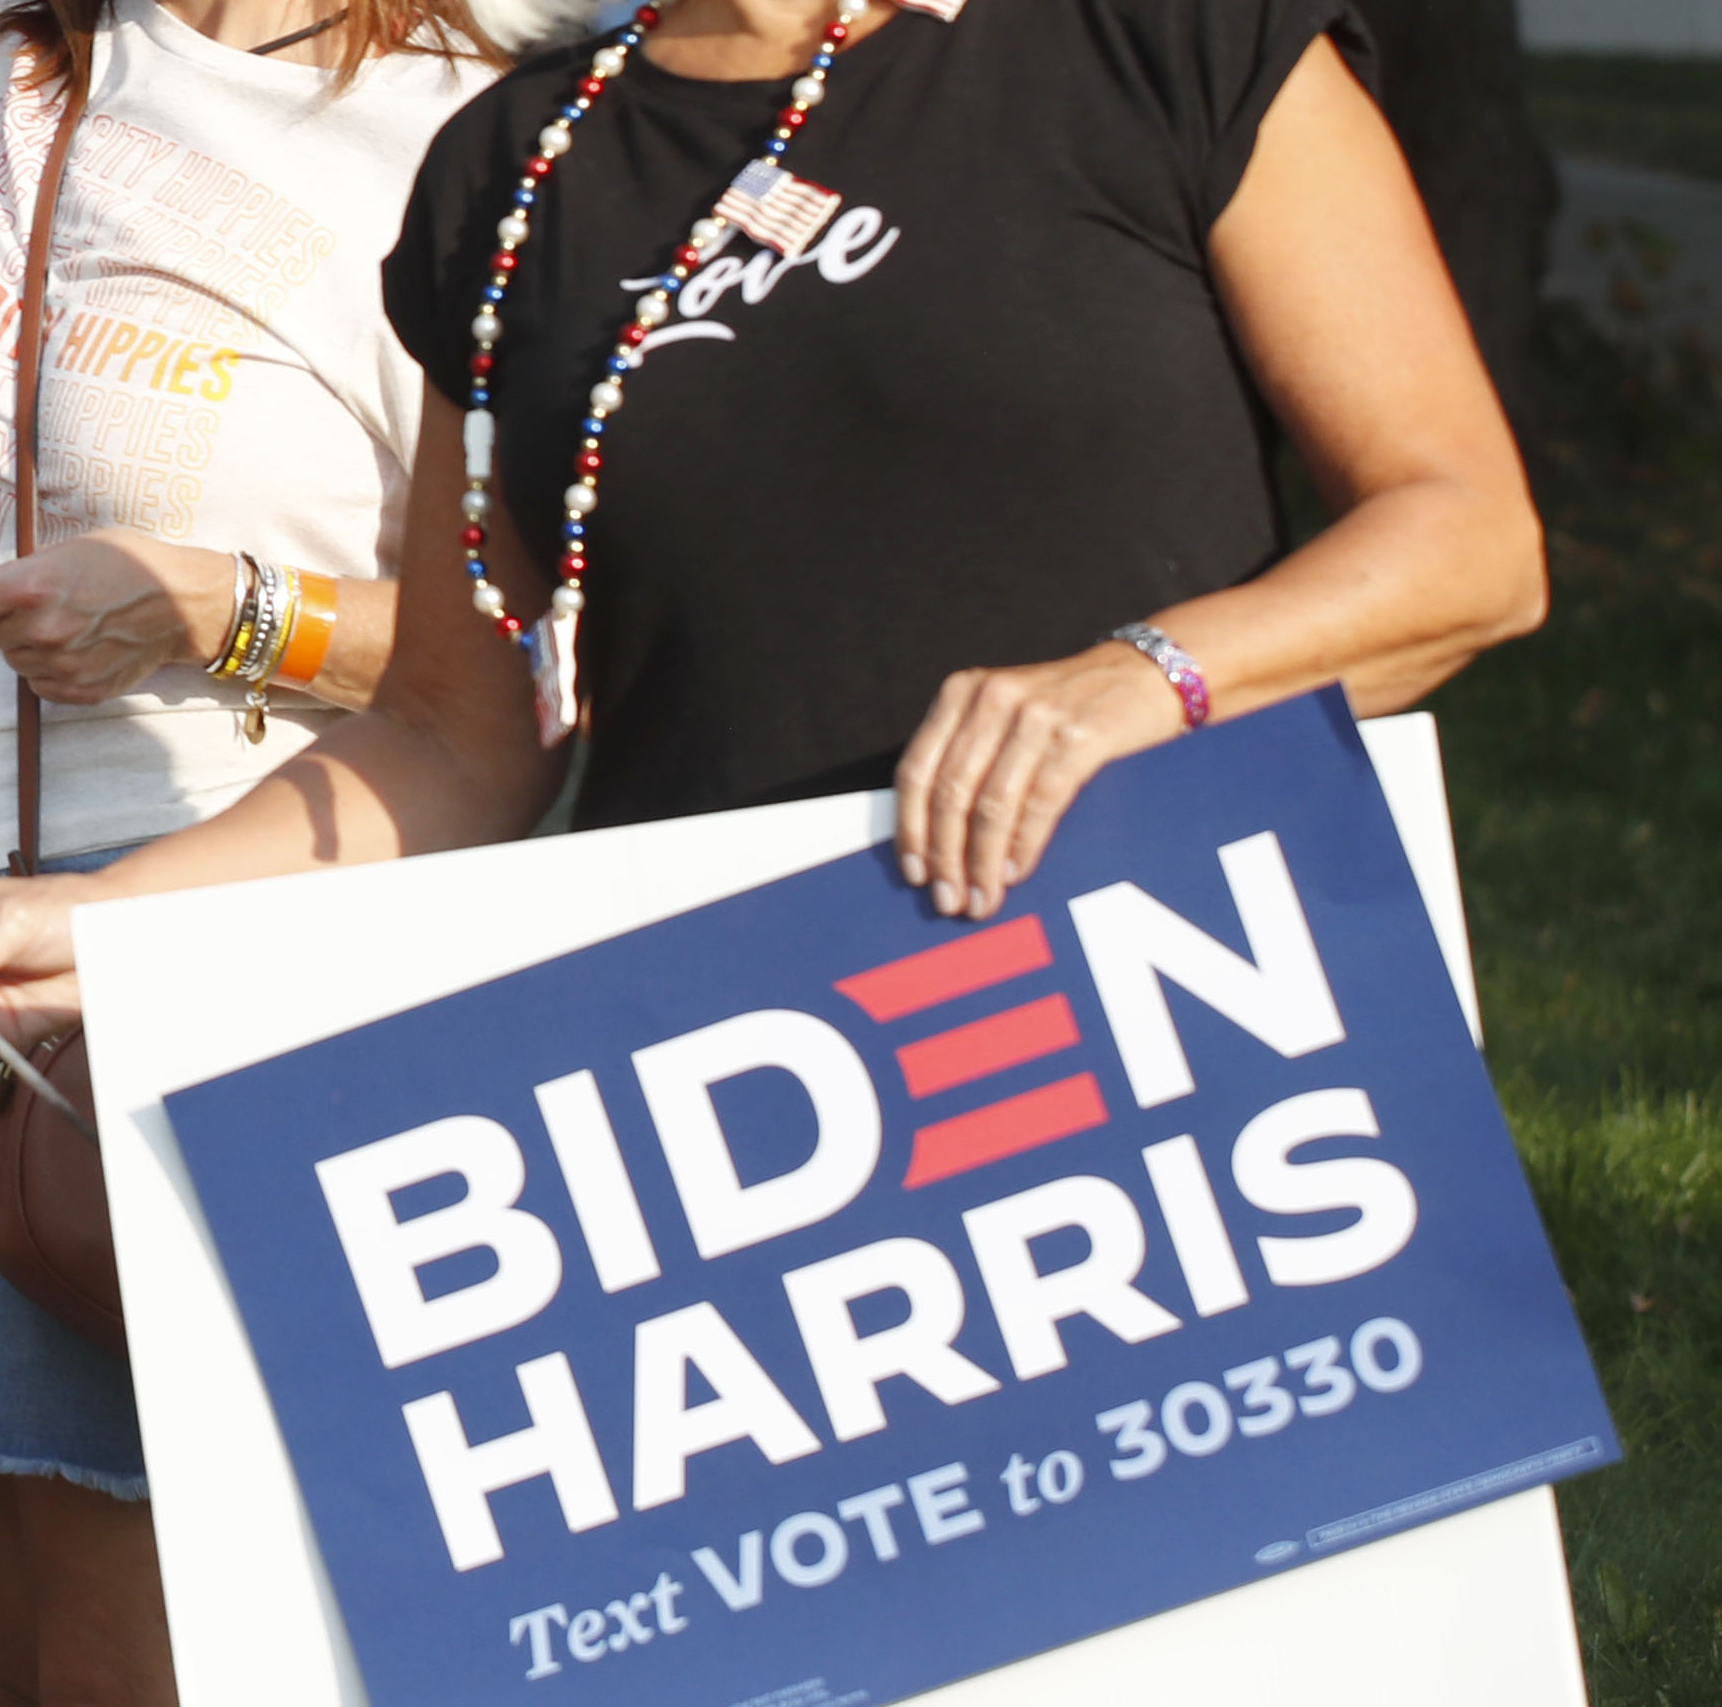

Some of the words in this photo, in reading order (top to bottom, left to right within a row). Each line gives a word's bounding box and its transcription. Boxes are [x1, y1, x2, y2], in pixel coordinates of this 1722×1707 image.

[54, 311, 242, 403] HIPPIES
[152, 149, 337, 286] HIPPIES
[313, 827, 1348, 1372] BIDEN
[400, 1086, 1421, 1574] HARRIS
[505, 1576, 692, 1682] Text
[689, 1460, 985, 1615] VOTE
[997, 1445, 1087, 1518] to
[1093, 1314, 1425, 1483] 30330
